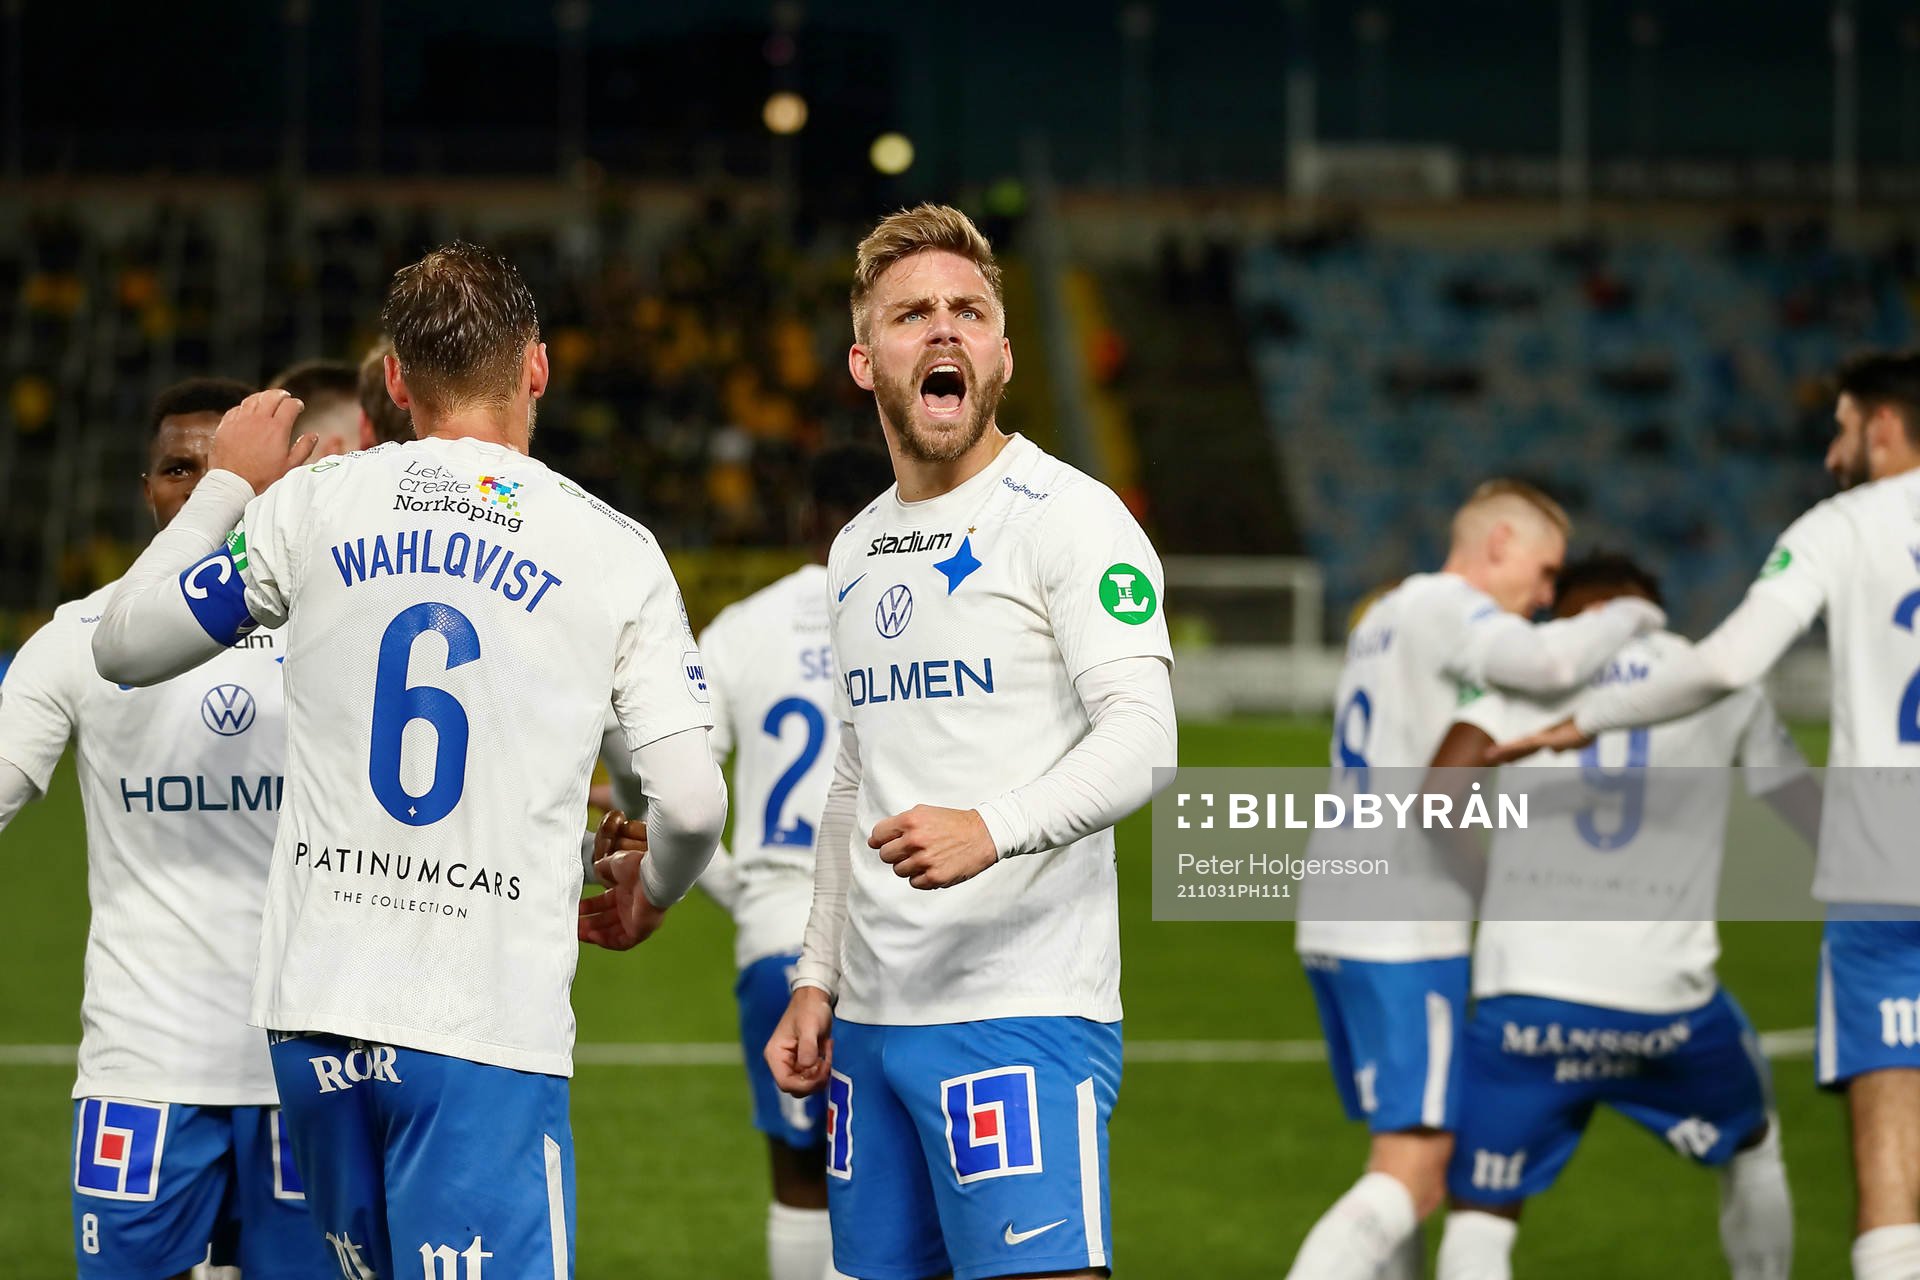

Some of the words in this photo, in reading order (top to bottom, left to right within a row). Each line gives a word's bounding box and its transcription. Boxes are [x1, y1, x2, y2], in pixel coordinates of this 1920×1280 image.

[398, 477, 471, 493] Create
[392, 494, 524, 533] Norrköping
[866, 530, 953, 557] stadium
[184, 555, 232, 599] C
[331, 529, 562, 613] WAHLQVIST
[1117, 588, 1133, 598] LE
[368, 601, 481, 827] 6
[120, 775, 284, 813] HOLM
[295, 841, 521, 901] PATINUMCARS
[333, 889, 362, 905] THE
[371, 894, 469, 919] COLLECTION
[309, 1039, 402, 1094] RÖR
[82, 1213, 100, 1254] 8
